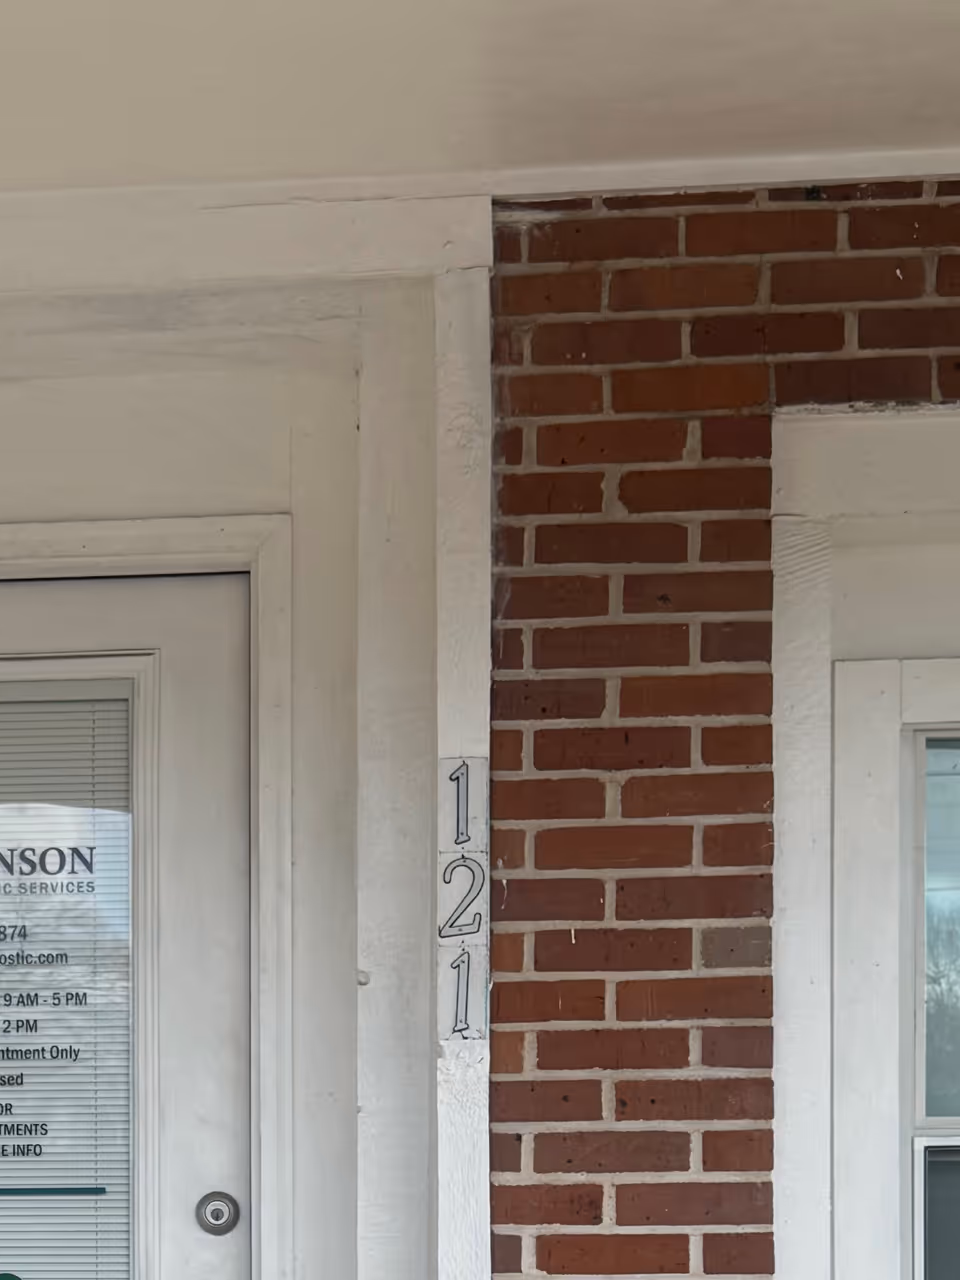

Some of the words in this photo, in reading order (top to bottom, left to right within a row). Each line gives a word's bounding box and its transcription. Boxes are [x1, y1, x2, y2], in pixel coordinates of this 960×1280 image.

[18, 881, 96, 895] SERVICES
[3, 993, 12, 1007] 9
[16, 992, 39, 1007] AM
[52, 992, 61, 1006] 5
[65, 992, 88, 1006] PM
[2, 1019, 11, 1033] 2
[16, 1019, 38, 1033] PM
[49, 1045, 81, 1062] Only
[12, 1144, 43, 1157] INFO
